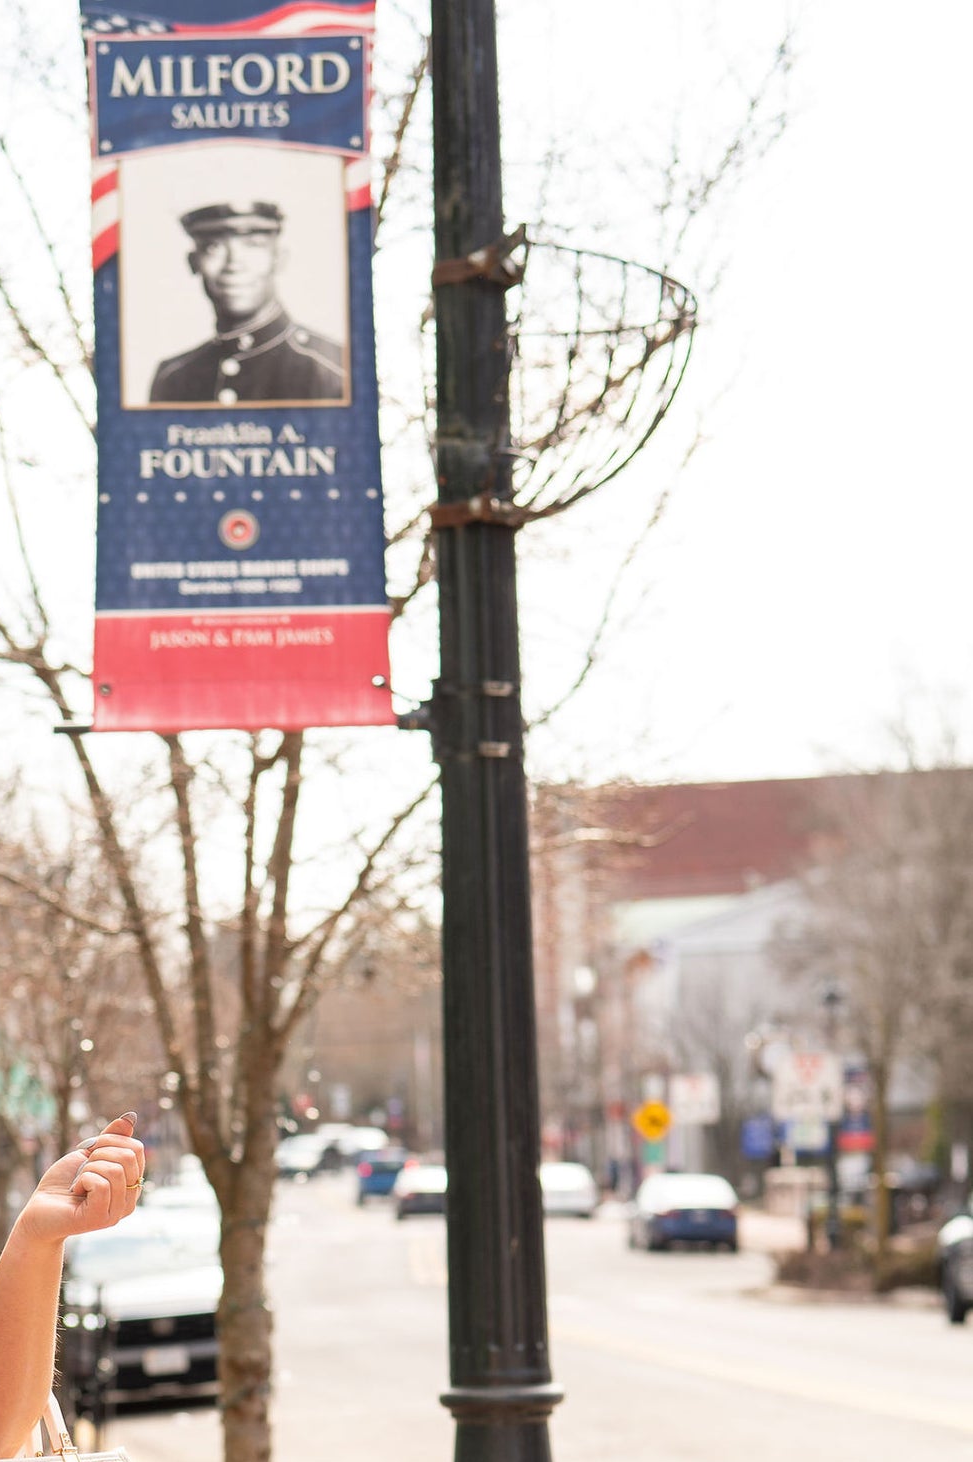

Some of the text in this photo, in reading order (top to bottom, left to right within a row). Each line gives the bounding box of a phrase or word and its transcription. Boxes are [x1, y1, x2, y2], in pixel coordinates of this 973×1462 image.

[109, 53, 351, 98] MILFORD
[171, 102, 291, 129] SALUTES
[167, 422, 306, 446] Franklin A.
[139, 446, 336, 479] FOUNTAIN
[150, 629, 210, 650] JASON
[212, 629, 229, 647] &
[276, 627, 334, 648] JAMES
